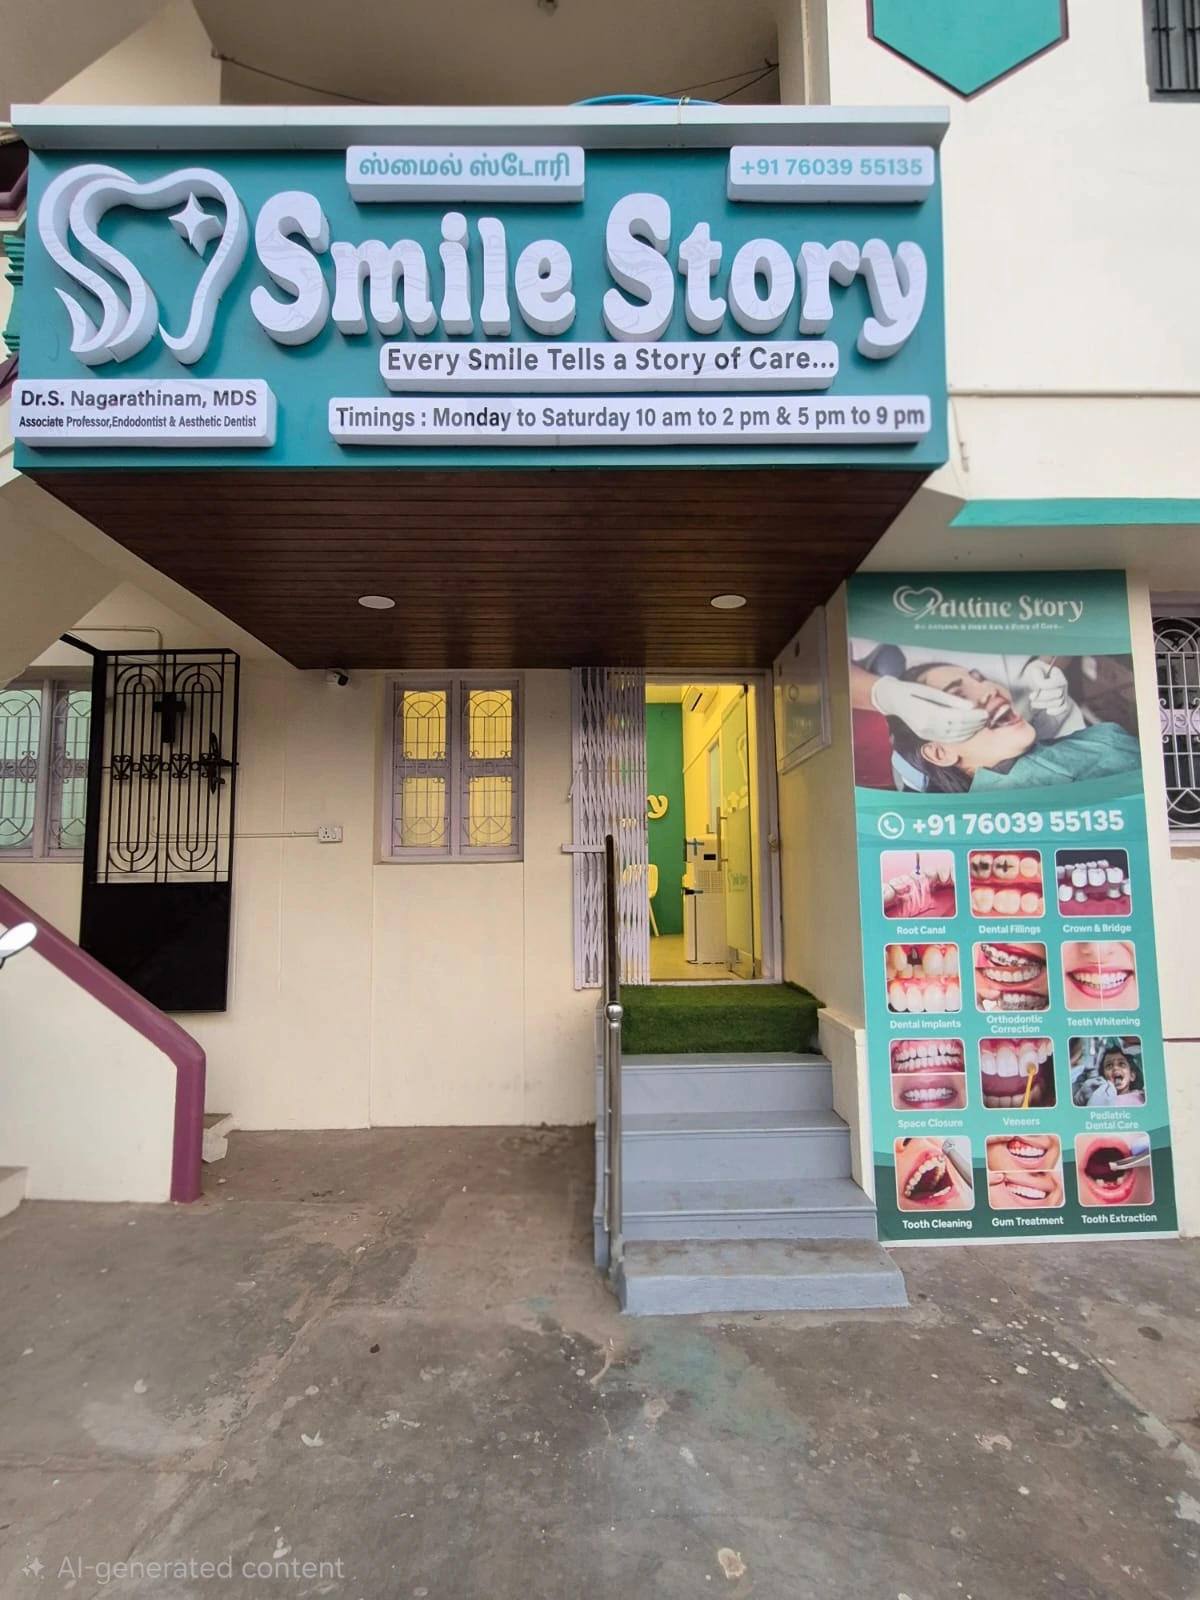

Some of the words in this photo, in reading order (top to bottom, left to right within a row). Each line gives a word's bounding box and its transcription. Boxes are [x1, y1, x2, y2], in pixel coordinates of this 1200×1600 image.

[359, 152, 463, 175] ஸ்மைல்
[470, 152, 570, 181] ஸ்டோரி
[740, 158, 778, 176] +91
[786, 158, 853, 176] 76039
[860, 158, 923, 176] 55135
[250, 190, 576, 346] Smile
[603, 192, 928, 360] Story
[388, 348, 459, 376] Every
[468, 348, 538, 371] Smile
[547, 348, 605, 370] Tells
[613, 353, 626, 370] a
[635, 348, 706, 375] Story
[714, 346, 741, 370] of
[750, 346, 835, 370] Care...
[21, 390, 65, 406] Dr.S.
[70, 389, 207, 410] Nagarathinam,
[213, 390, 257, 406] MDS
[19, 416, 64, 428] Associate
[169, 416, 176, 427] &
[178, 415, 222, 427] Aesthetic
[223, 415, 257, 427] Dentist
[335, 406, 415, 431] Timings
[433, 406, 511, 431] Monday
[516, 408, 537, 427] to
[542, 406, 630, 430] Saturday
[636, 408, 656, 426] 10
[662, 411, 691, 426] am
[698, 410, 717, 426] to
[723, 408, 735, 426] 2
[740, 411, 770, 430] pm
[776, 406, 792, 426] &
[798, 407, 809, 425] 5
[815, 410, 845, 429] pm
[851, 407, 870, 425] to
[877, 406, 888, 424] 9
[894, 409, 925, 429] pm
[913, 814, 956, 836] +91
[962, 811, 1044, 835] 76039
[1050, 809, 1125, 832] 55135
[896, 925, 918, 935] Root
[920, 925, 946, 935] Canal
[978, 925, 1008, 934] Dental
[1010, 924, 1041, 935] Fillings
[1062, 924, 1092, 933] Crown
[1102, 923, 1131, 934] Bridge
[889, 1019, 919, 1029] Dental
[921, 1018, 961, 1030] Implants
[986, 1014, 1043, 1024] Orthodontic
[1067, 1017, 1092, 1027] Teeth
[1093, 1016, 1140, 1027] Whitening
[990, 1024, 1040, 1034] Correction
[1090, 1111, 1131, 1120] Pediatric
[897, 1119, 926, 1129] Space
[927, 1118, 964, 1128] Closure
[1002, 1117, 1041, 1126] Veneers
[1085, 1120, 1115, 1130] Dental
[1116, 1120, 1139, 1129] Care
[902, 1219, 930, 1229] Tooth
[931, 1218, 973, 1230] Cleaning
[991, 1217, 1014, 1227] Gum
[1015, 1215, 1064, 1226] Treatment
[1081, 1214, 1108, 1224] Tooth
[1109, 1213, 1157, 1223] Extraction
